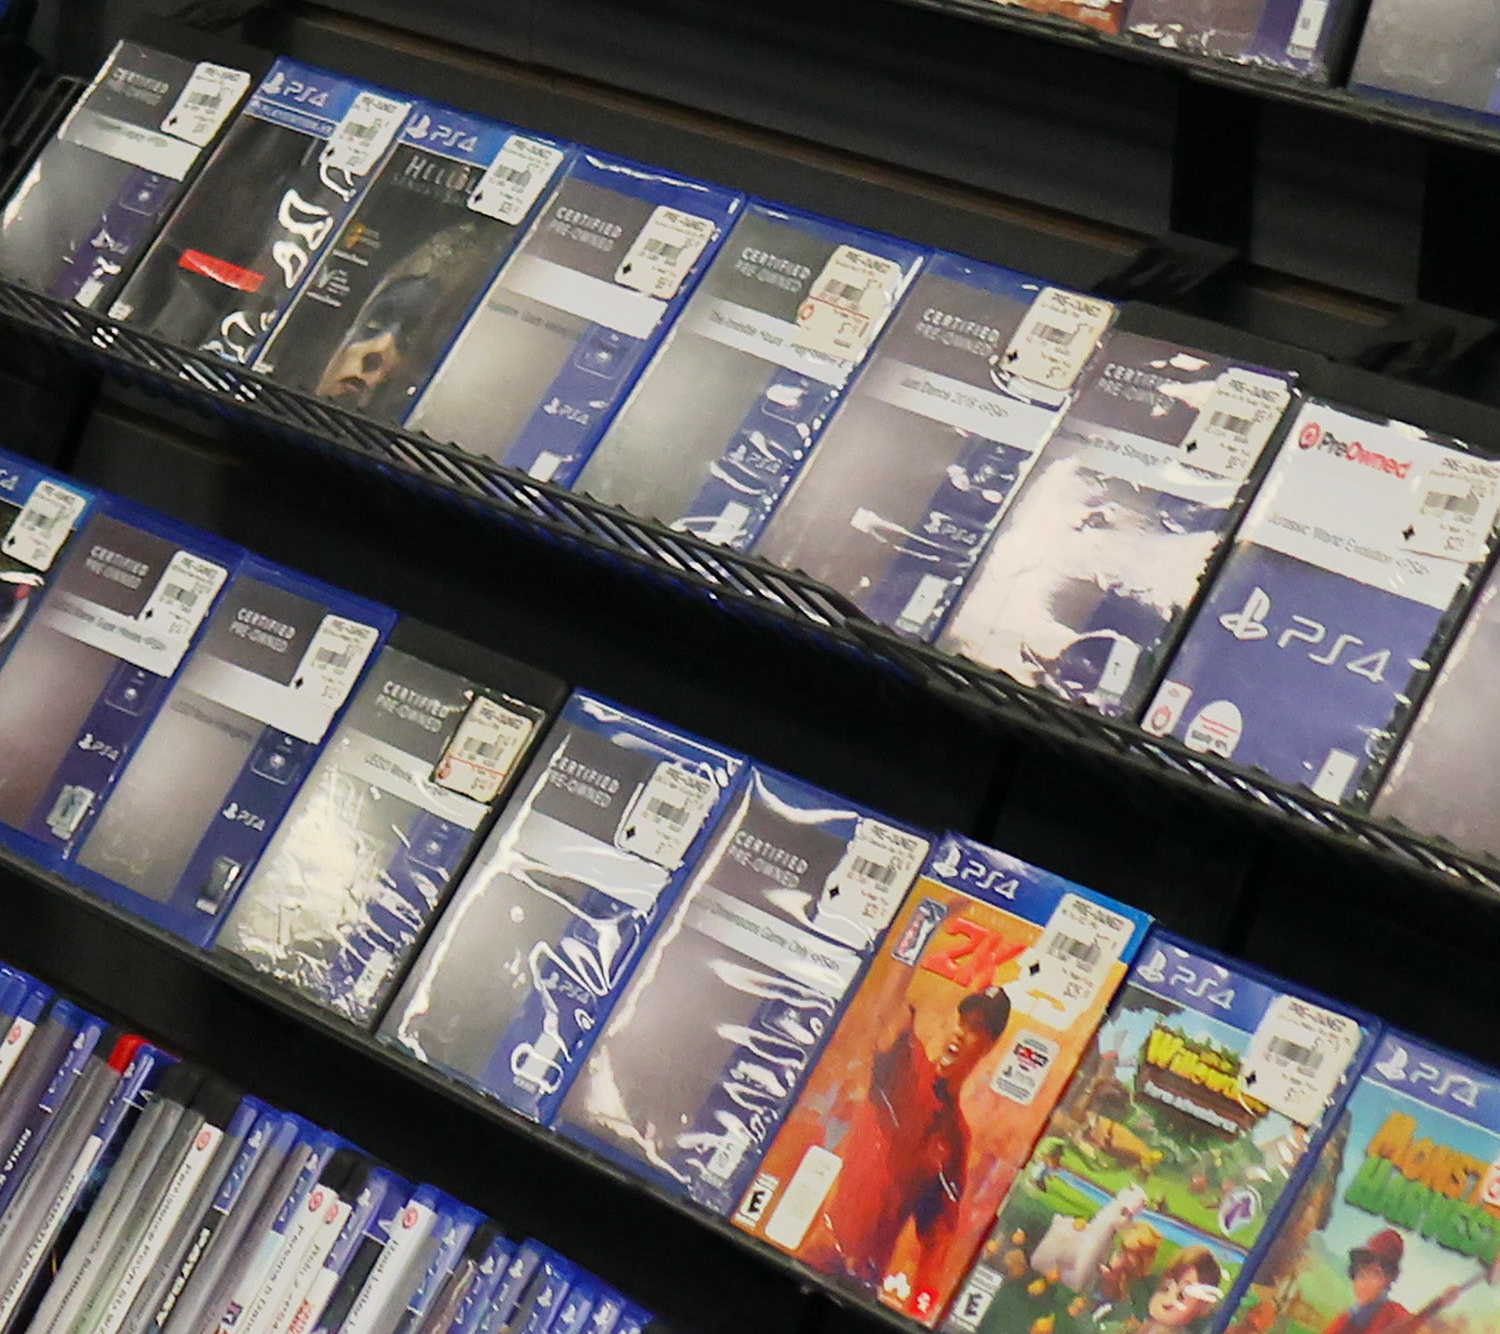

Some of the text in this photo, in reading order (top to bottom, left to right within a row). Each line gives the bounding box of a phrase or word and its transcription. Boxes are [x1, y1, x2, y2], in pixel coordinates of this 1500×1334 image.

[281, 81, 328, 109] PS4
[430, 124, 479, 153] PS4
[555, 205, 624, 239] CERTIFIED
[921, 307, 1001, 342] CERTIFIED
[1321, 432, 1412, 479] PreOwned
[237, 607, 297, 639] CERTIFIED
[1277, 614, 1392, 684] PS4
[734, 829, 808, 875] CERTIFIED
[958, 859, 1020, 901] PS4
[1168, 965, 1237, 1013] PS4
[2, 1126, 33, 1173] NINJA
[152, 1224, 212, 1329] PAYDAY
